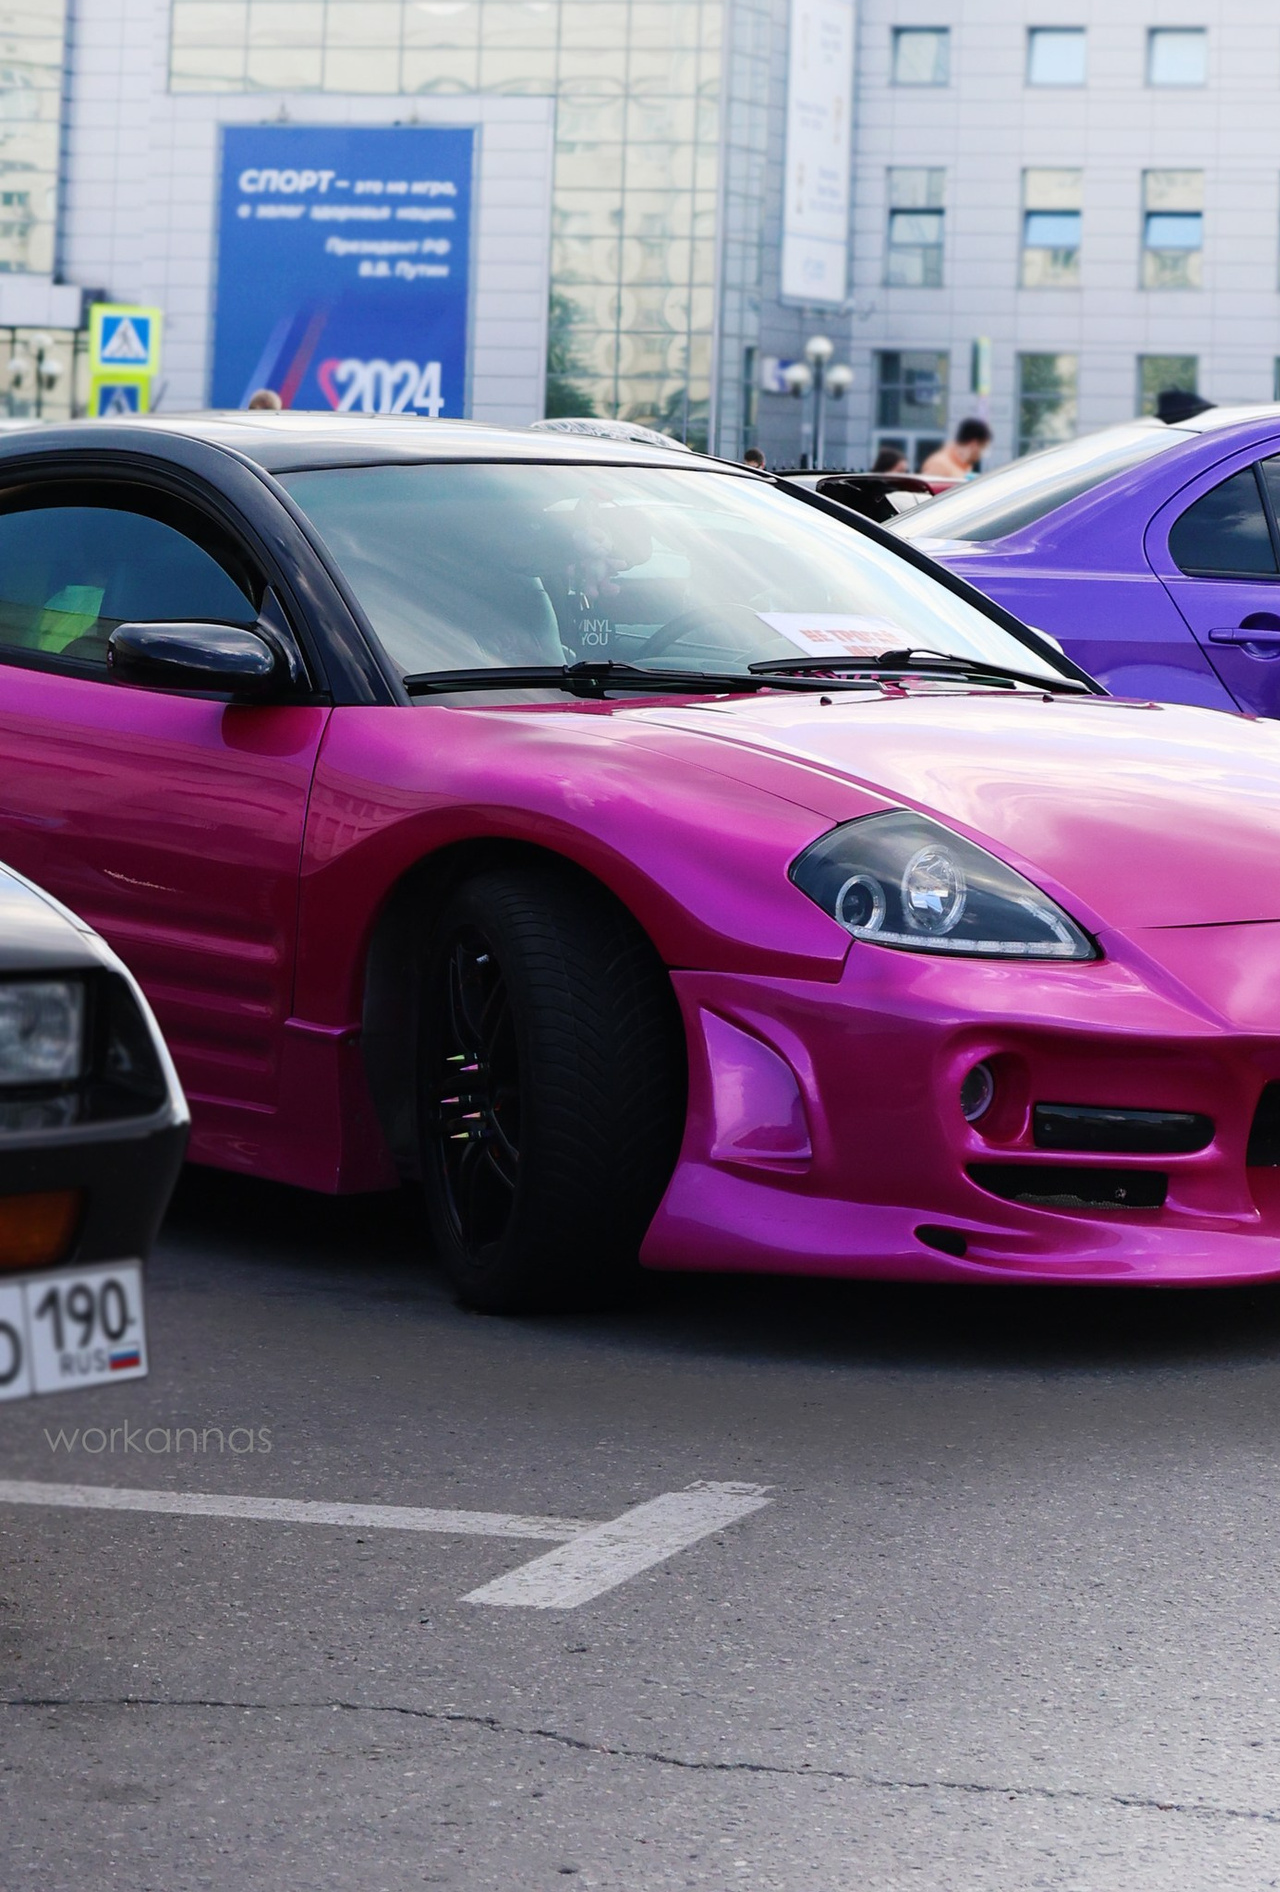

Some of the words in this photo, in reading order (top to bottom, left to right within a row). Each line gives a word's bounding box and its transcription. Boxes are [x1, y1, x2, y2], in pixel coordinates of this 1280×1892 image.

[239, 169, 336, 193] СПОРТ
[336, 358, 445, 417] 2024
[34, 1278, 129, 1351] 190
[59, 1349, 108, 1377] RUS
